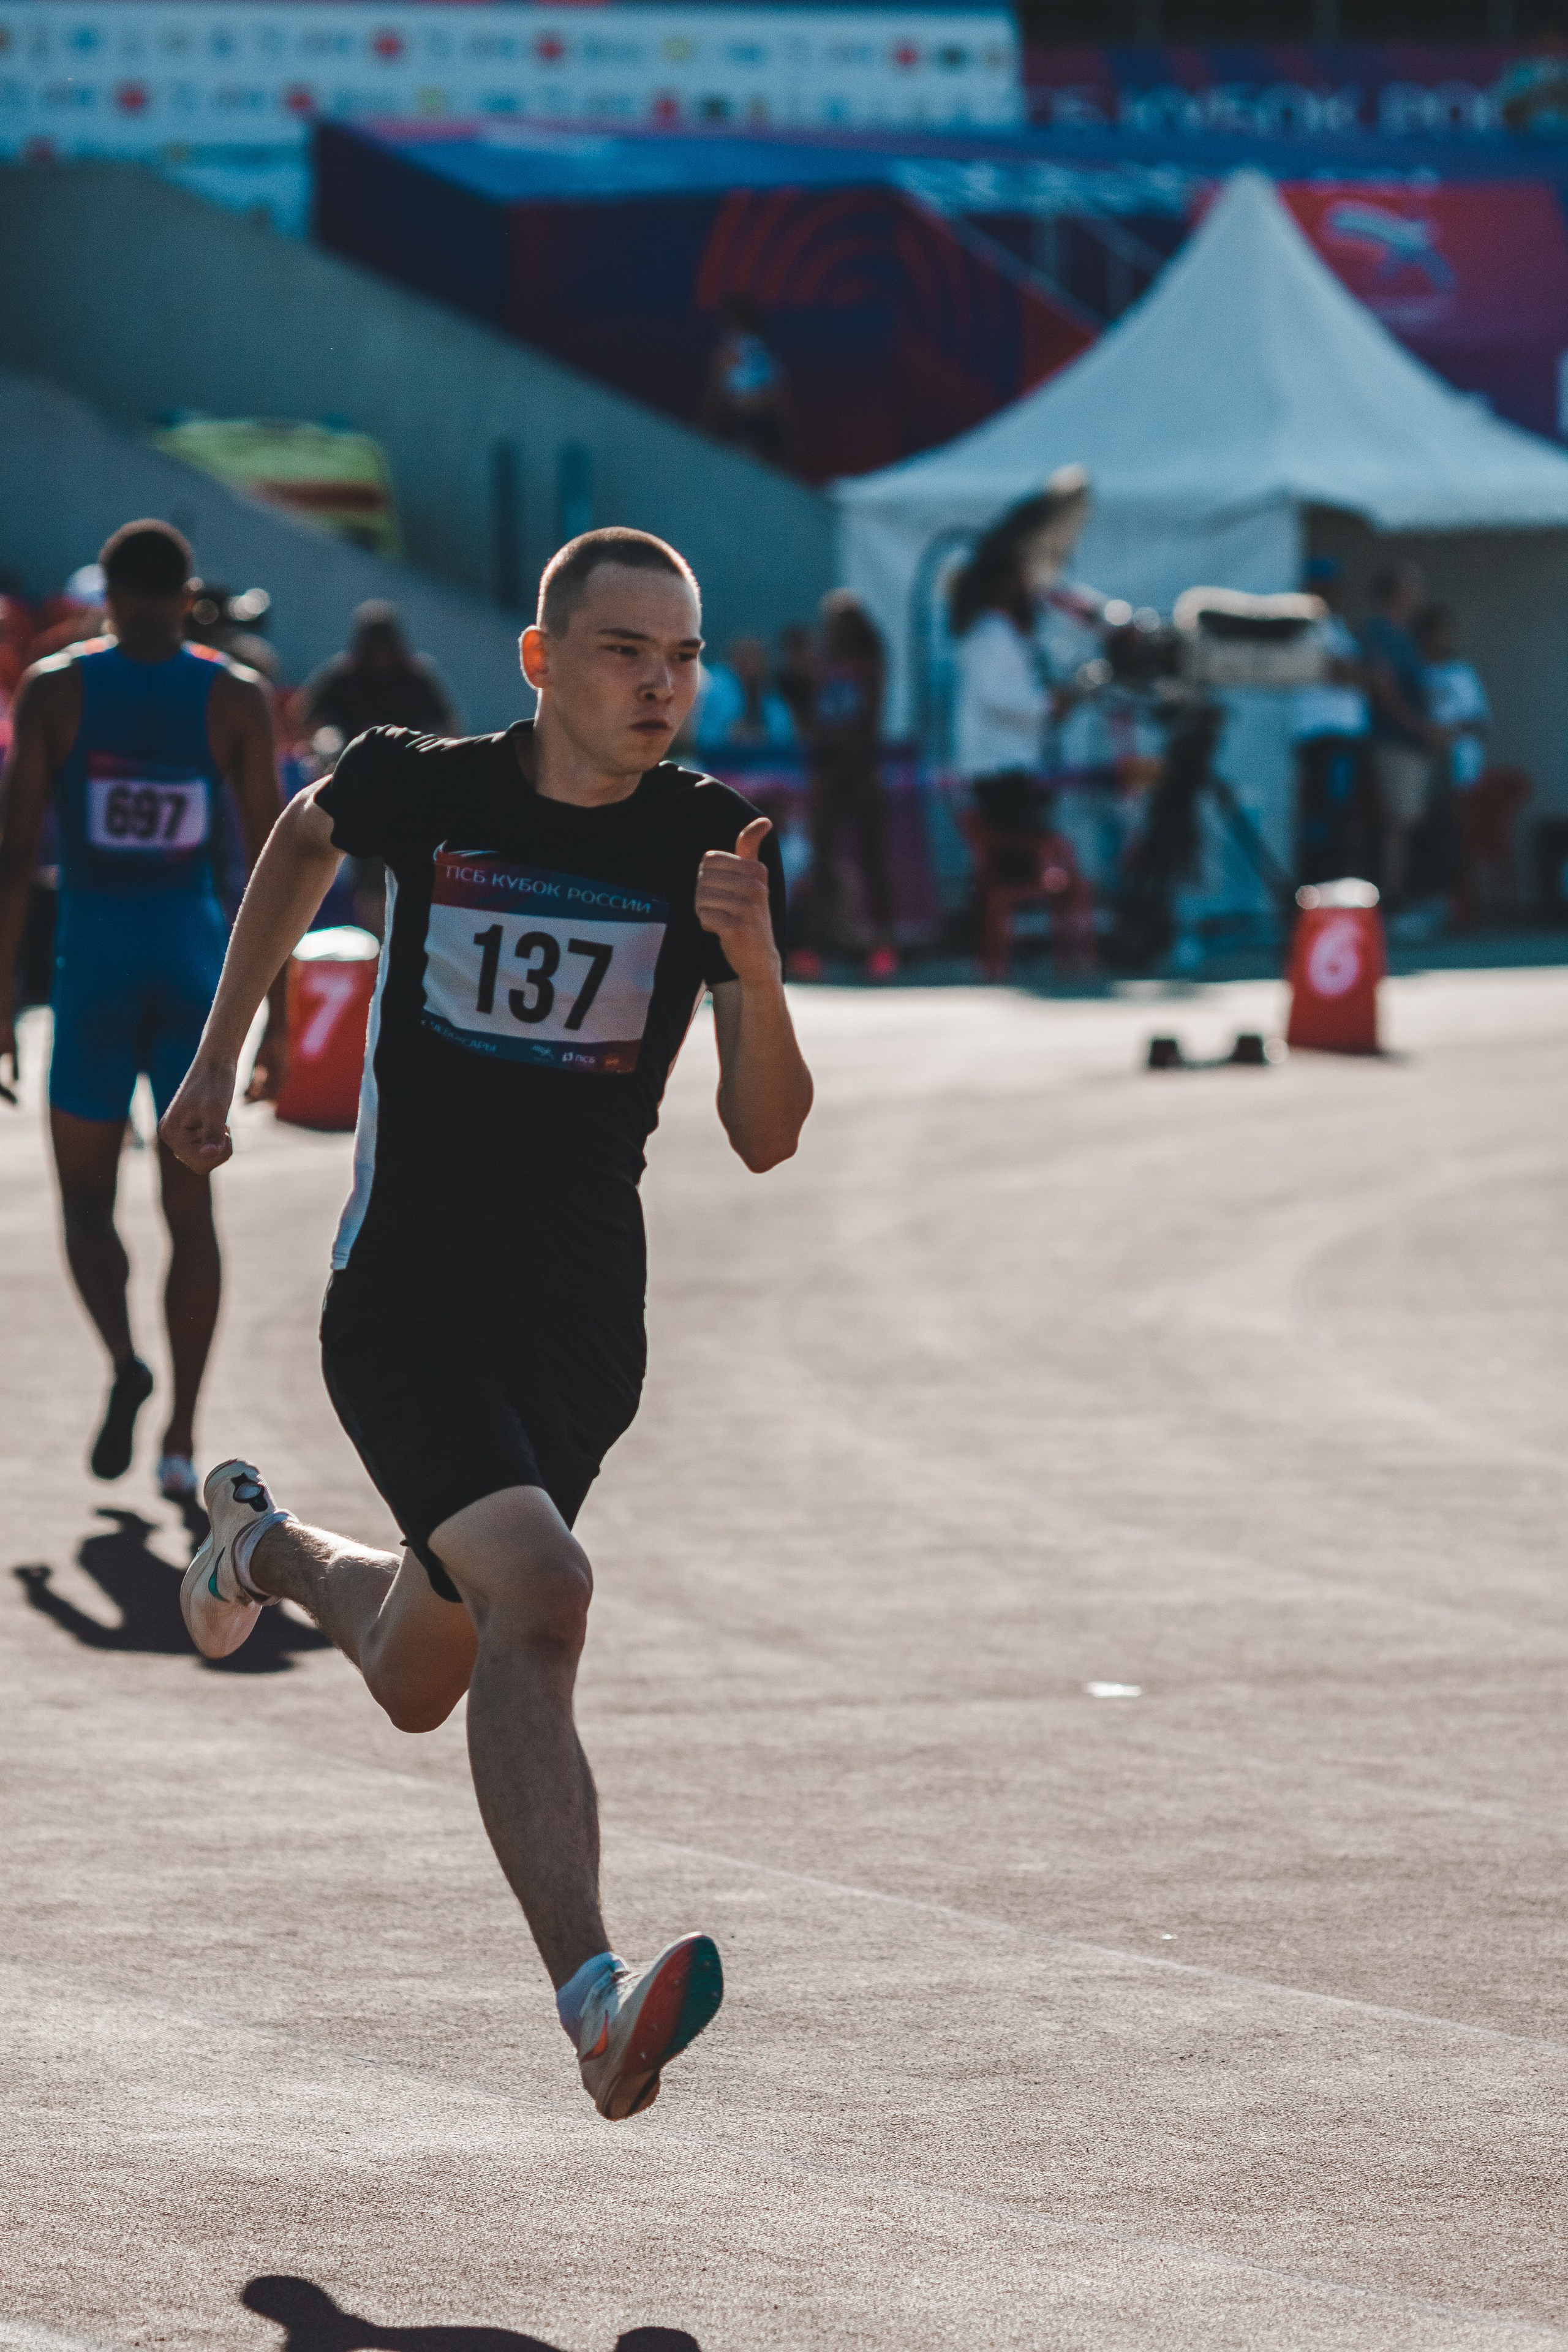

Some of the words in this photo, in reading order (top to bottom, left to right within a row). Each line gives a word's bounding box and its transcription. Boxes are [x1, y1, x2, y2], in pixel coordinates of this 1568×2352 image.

[107, 787, 187, 838] 697
[446, 865, 486, 883] ПСБ
[492, 874, 559, 898] КУБОК
[568, 887, 652, 914] РОССИИ
[474, 924, 613, 1031] 137
[1309, 916, 1363, 997] 6
[304, 977, 353, 1058] 7
